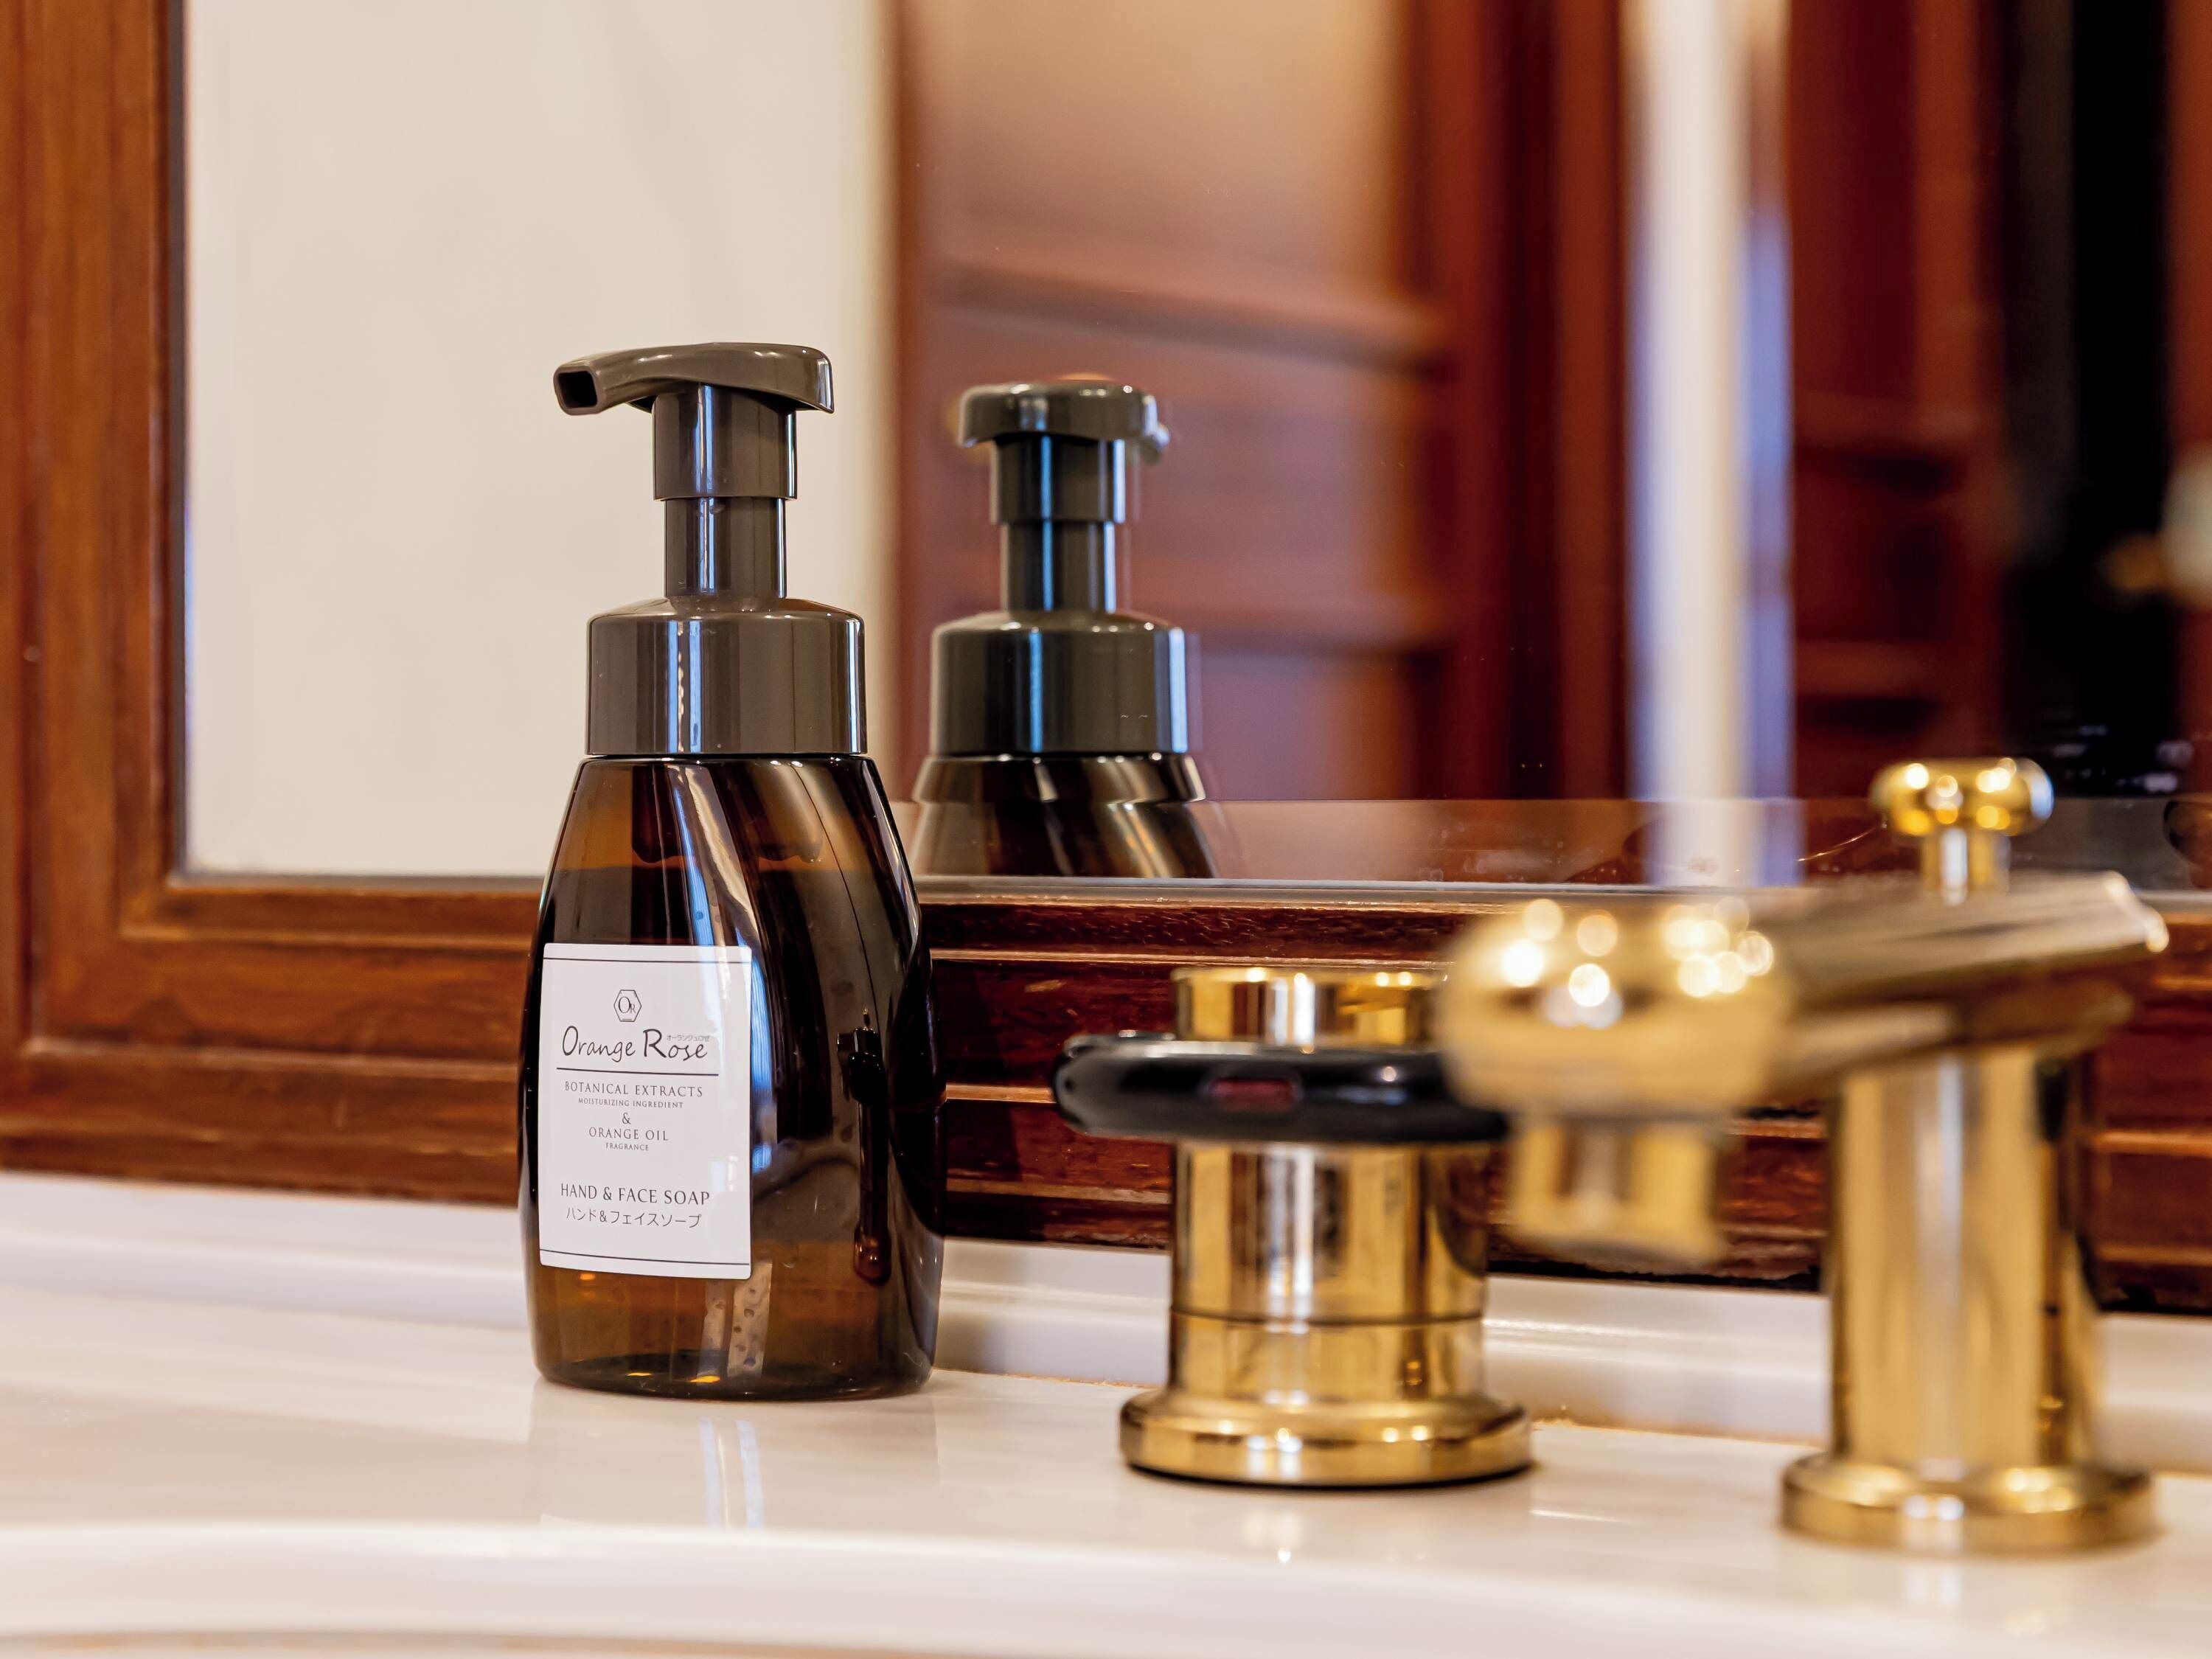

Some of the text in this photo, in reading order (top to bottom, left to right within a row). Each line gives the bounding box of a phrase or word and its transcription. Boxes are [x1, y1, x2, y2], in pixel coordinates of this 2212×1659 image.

[562, 1026, 708, 1062] Orange Rose
[565, 1081, 703, 1098] BOTANICAL EXTRACTS
[578, 1098, 684, 1108] MOISTURIZING INGREDIENT
[622, 1112, 632, 1124] &
[588, 1127, 669, 1141] ORANGE OIL
[605, 1142, 649, 1151] FRAGRANCE
[561, 1183, 709, 1205] HAND & FACE SOAP
